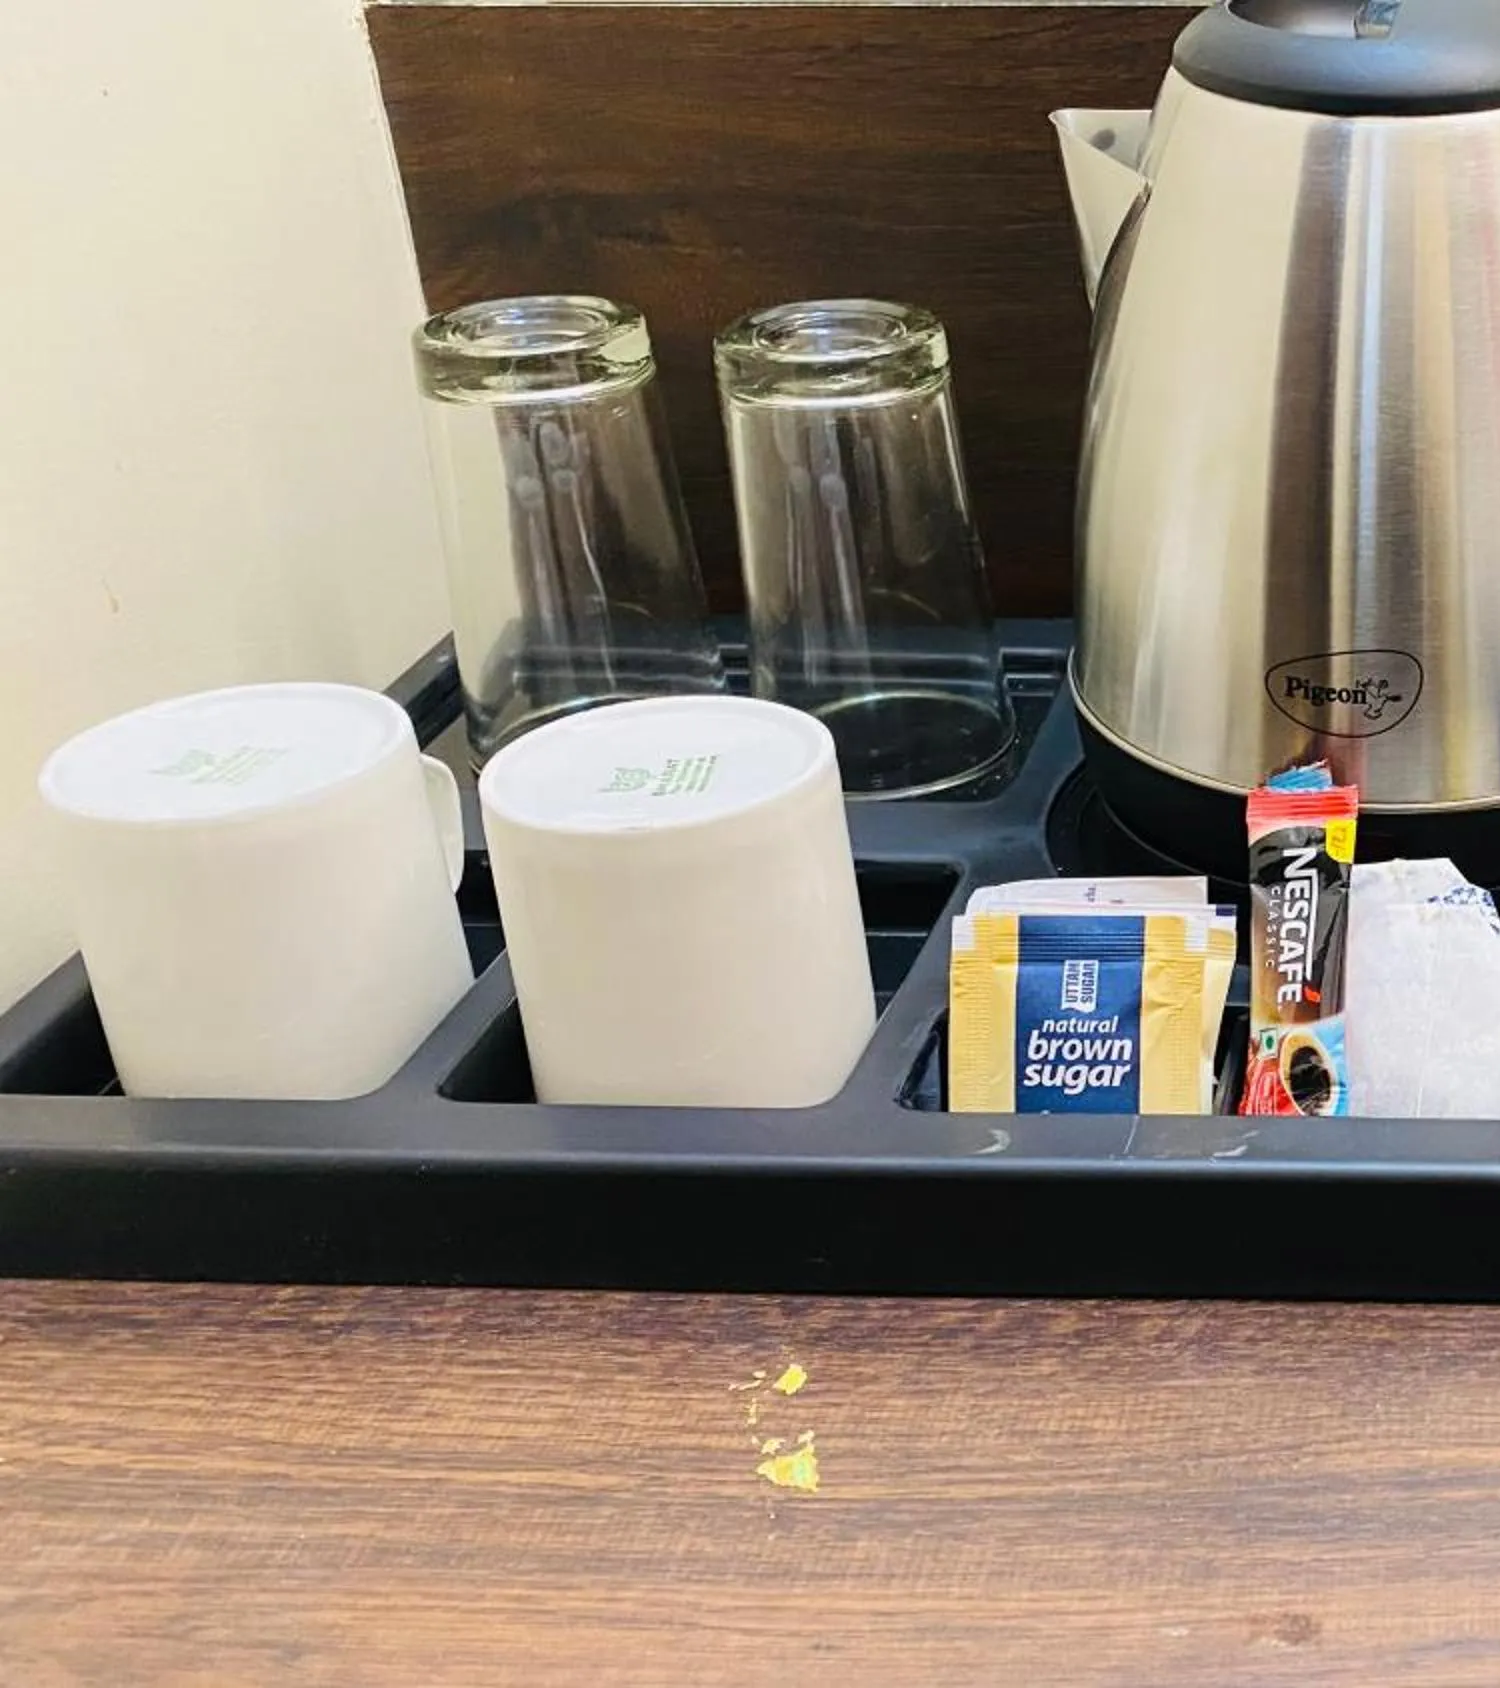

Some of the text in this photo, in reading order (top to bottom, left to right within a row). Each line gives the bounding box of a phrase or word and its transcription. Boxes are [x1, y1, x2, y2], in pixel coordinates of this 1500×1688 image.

[1284, 675, 1367, 707] Pigeon
[1265, 886, 1281, 969] CLASSIC
[1042, 1015, 1118, 1032] natural
[1027, 1030, 1133, 1061] brown
[1024, 1062, 1131, 1095] sugar
